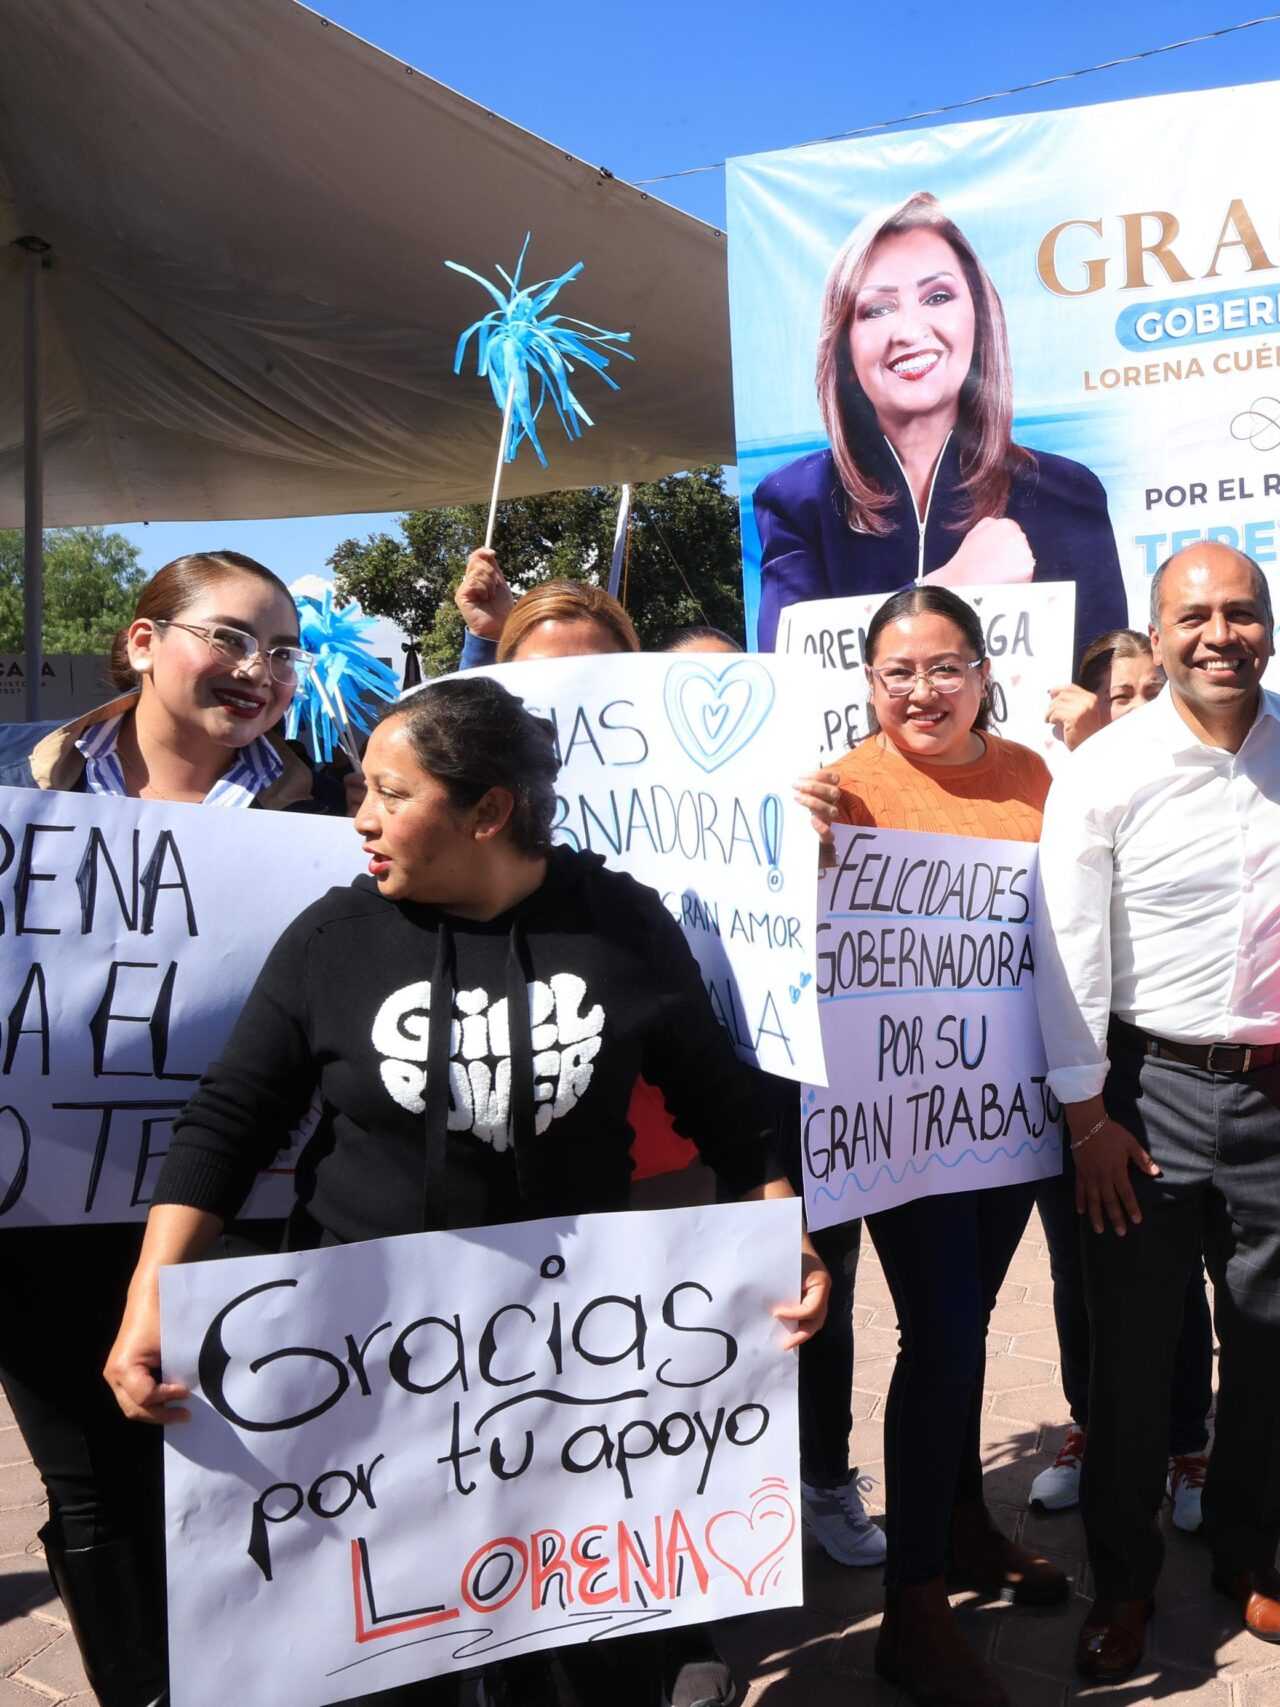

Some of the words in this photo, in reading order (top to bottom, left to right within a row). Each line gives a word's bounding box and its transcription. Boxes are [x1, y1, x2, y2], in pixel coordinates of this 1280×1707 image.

[1083, 357, 1206, 392] LORENA
[1144, 482, 1208, 511] POR
[1218, 478, 1254, 501] EL
[829, 832, 1030, 924] FELICIDADES
[729, 908, 805, 950] AMOR
[815, 922, 1036, 998] GOBERNADORA
[878, 1013, 924, 1082] POR
[935, 1014, 987, 1071] SU
[804, 1094, 893, 1184] GRAN
[906, 1076, 1062, 1157] TRABAJO
[198, 1254, 738, 1433] Gracias
[247, 1454, 385, 1582] por
[561, 1402, 770, 1499] apoyo
[351, 1509, 711, 1644] LORENA
